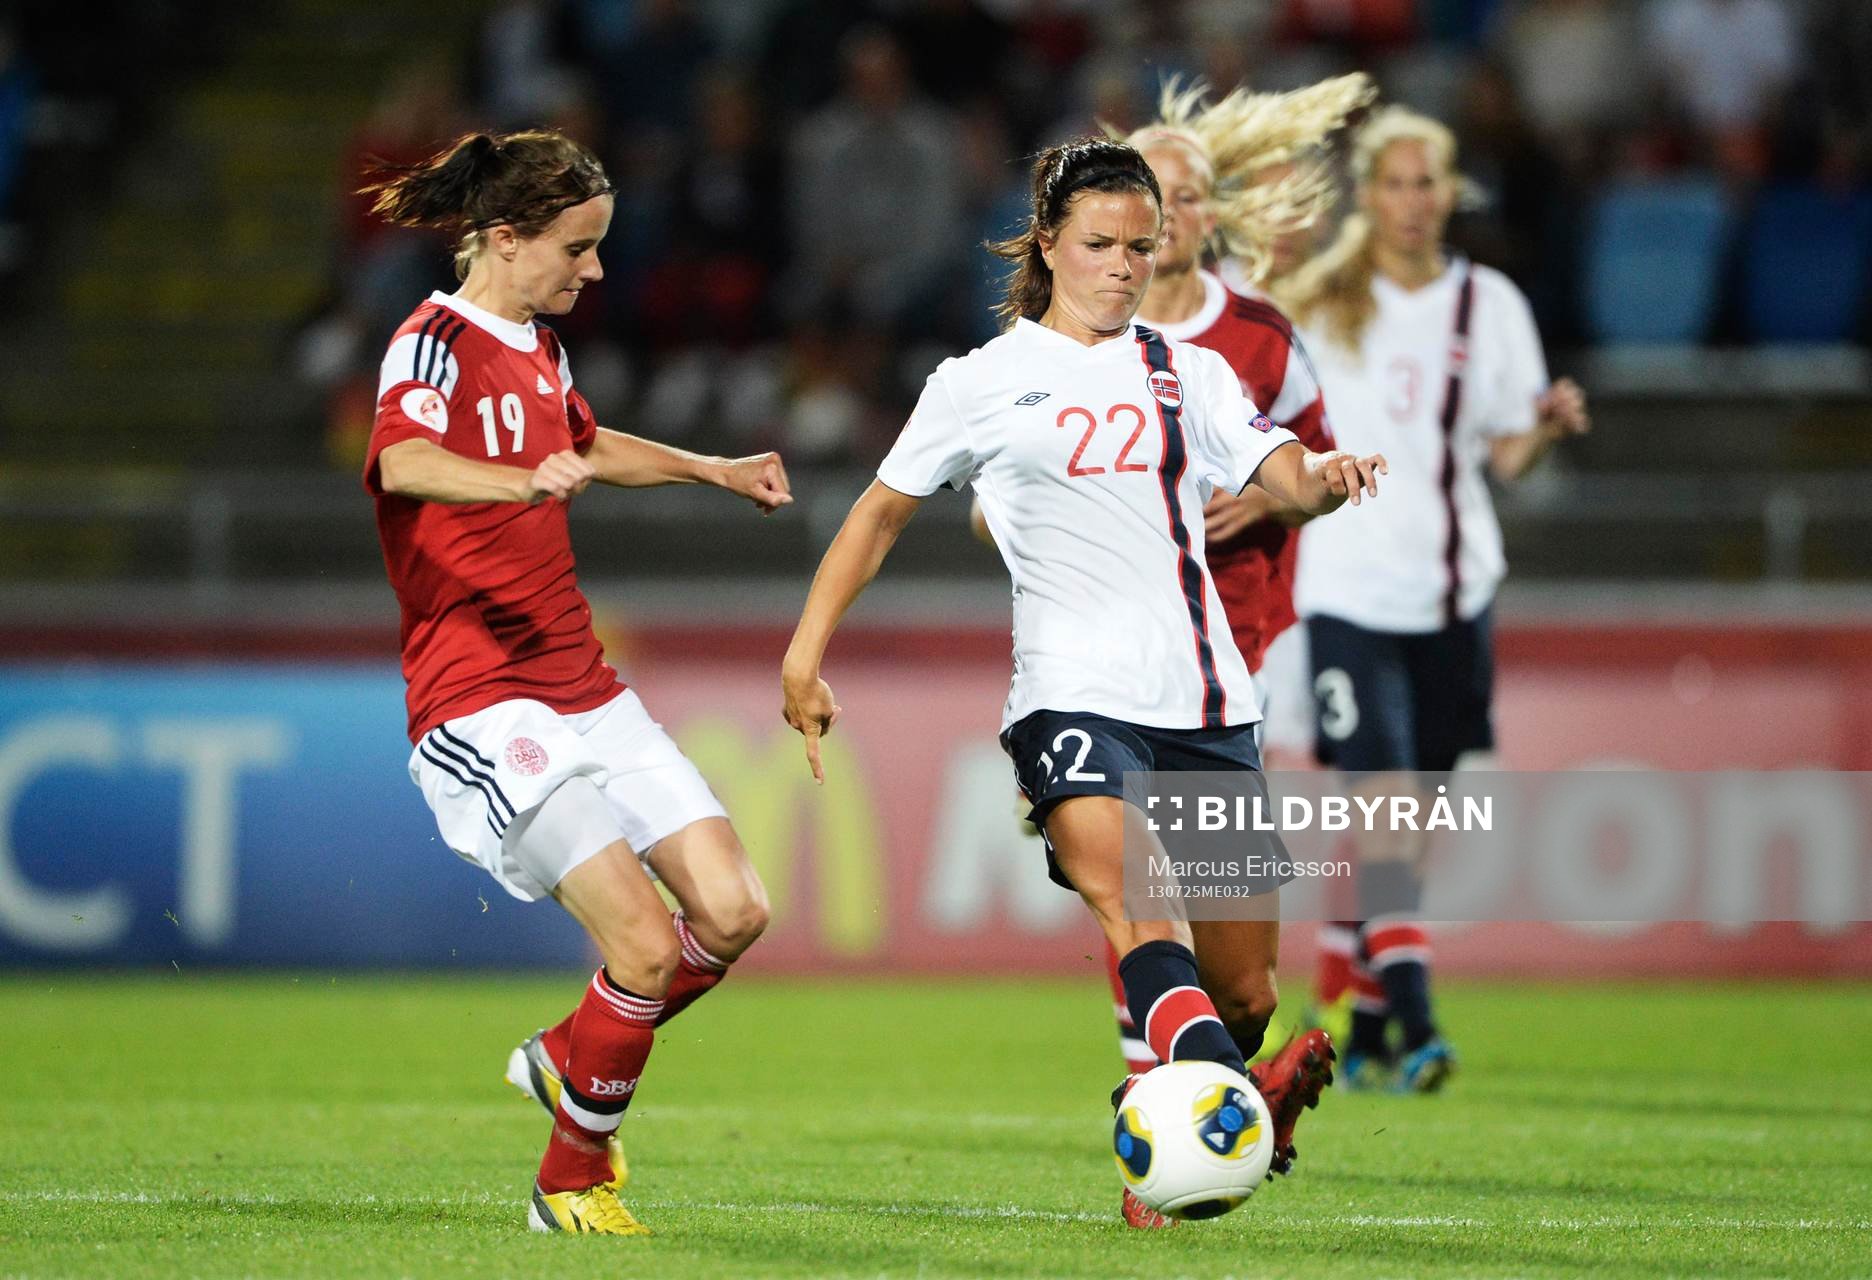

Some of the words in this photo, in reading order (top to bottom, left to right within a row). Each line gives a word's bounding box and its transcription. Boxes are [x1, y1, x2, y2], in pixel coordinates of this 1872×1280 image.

[476, 392, 525, 457] 19
[1386, 353, 1424, 425] 3
[1056, 403, 1148, 477] 22
[1314, 667, 1360, 740] 3
